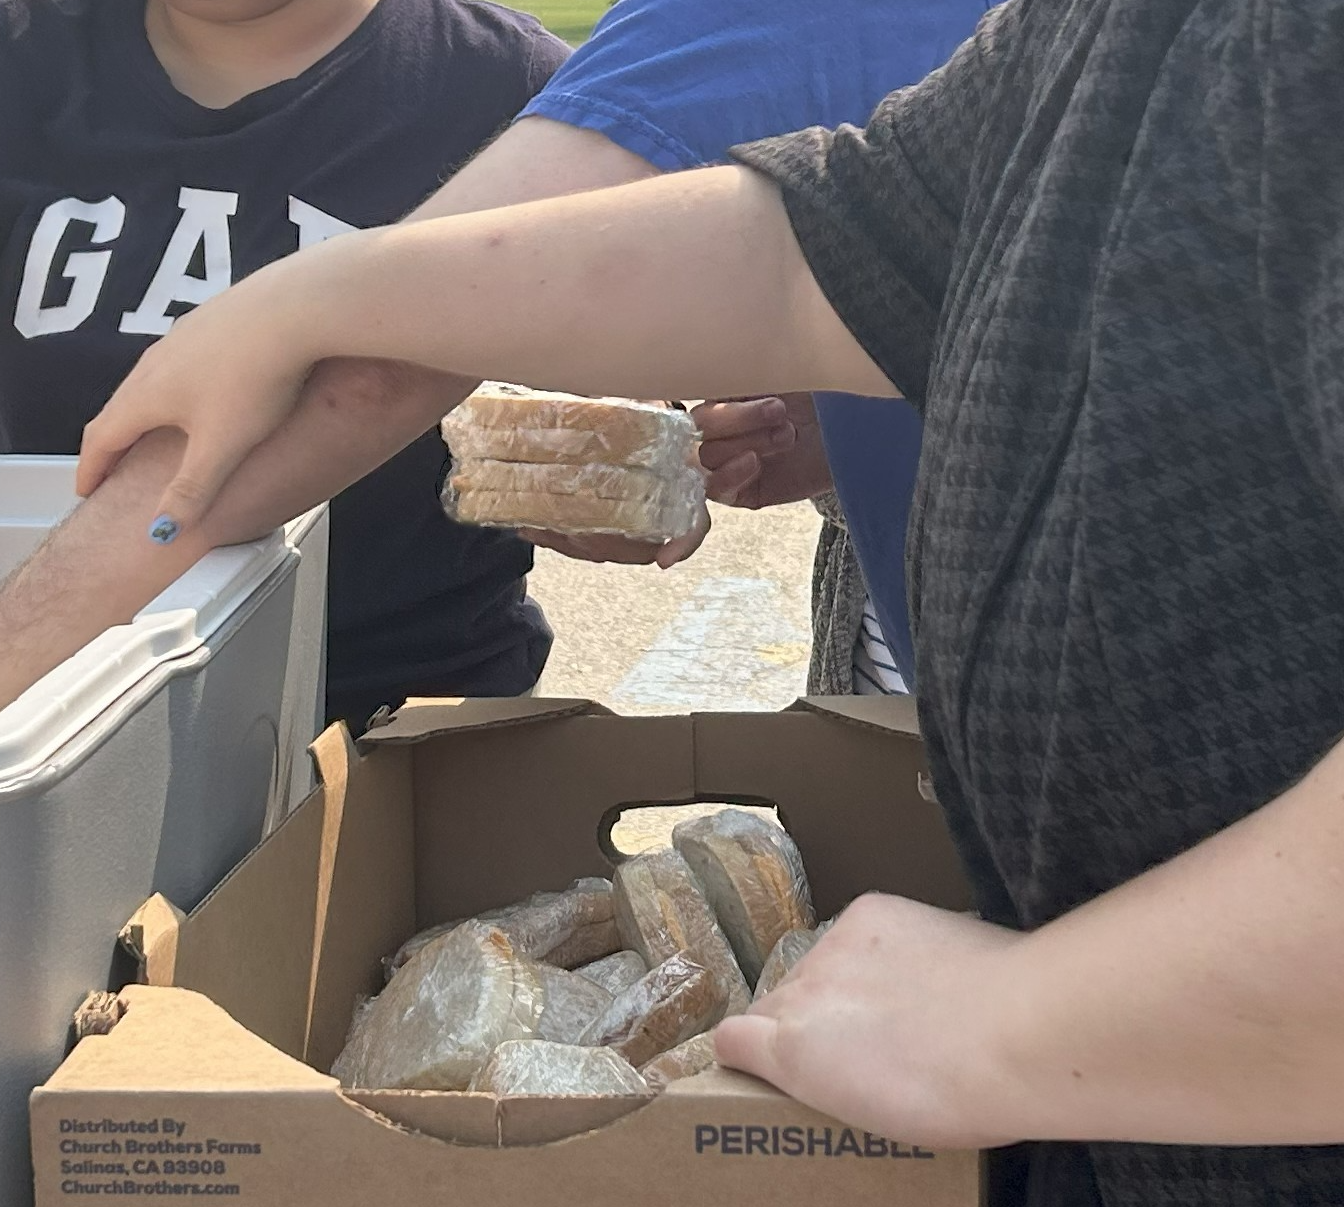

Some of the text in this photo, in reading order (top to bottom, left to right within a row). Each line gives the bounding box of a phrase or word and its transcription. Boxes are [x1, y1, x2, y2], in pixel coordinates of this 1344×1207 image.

[13, 186, 360, 339] GA
[59, 1118, 186, 1137] Distributed By
[59, 1139, 262, 1154] Church Brothers Farms
[60, 1159, 225, 1176] Salinas, CA 93908
[60, 1179, 241, 1195] ChurchBrothers.com
